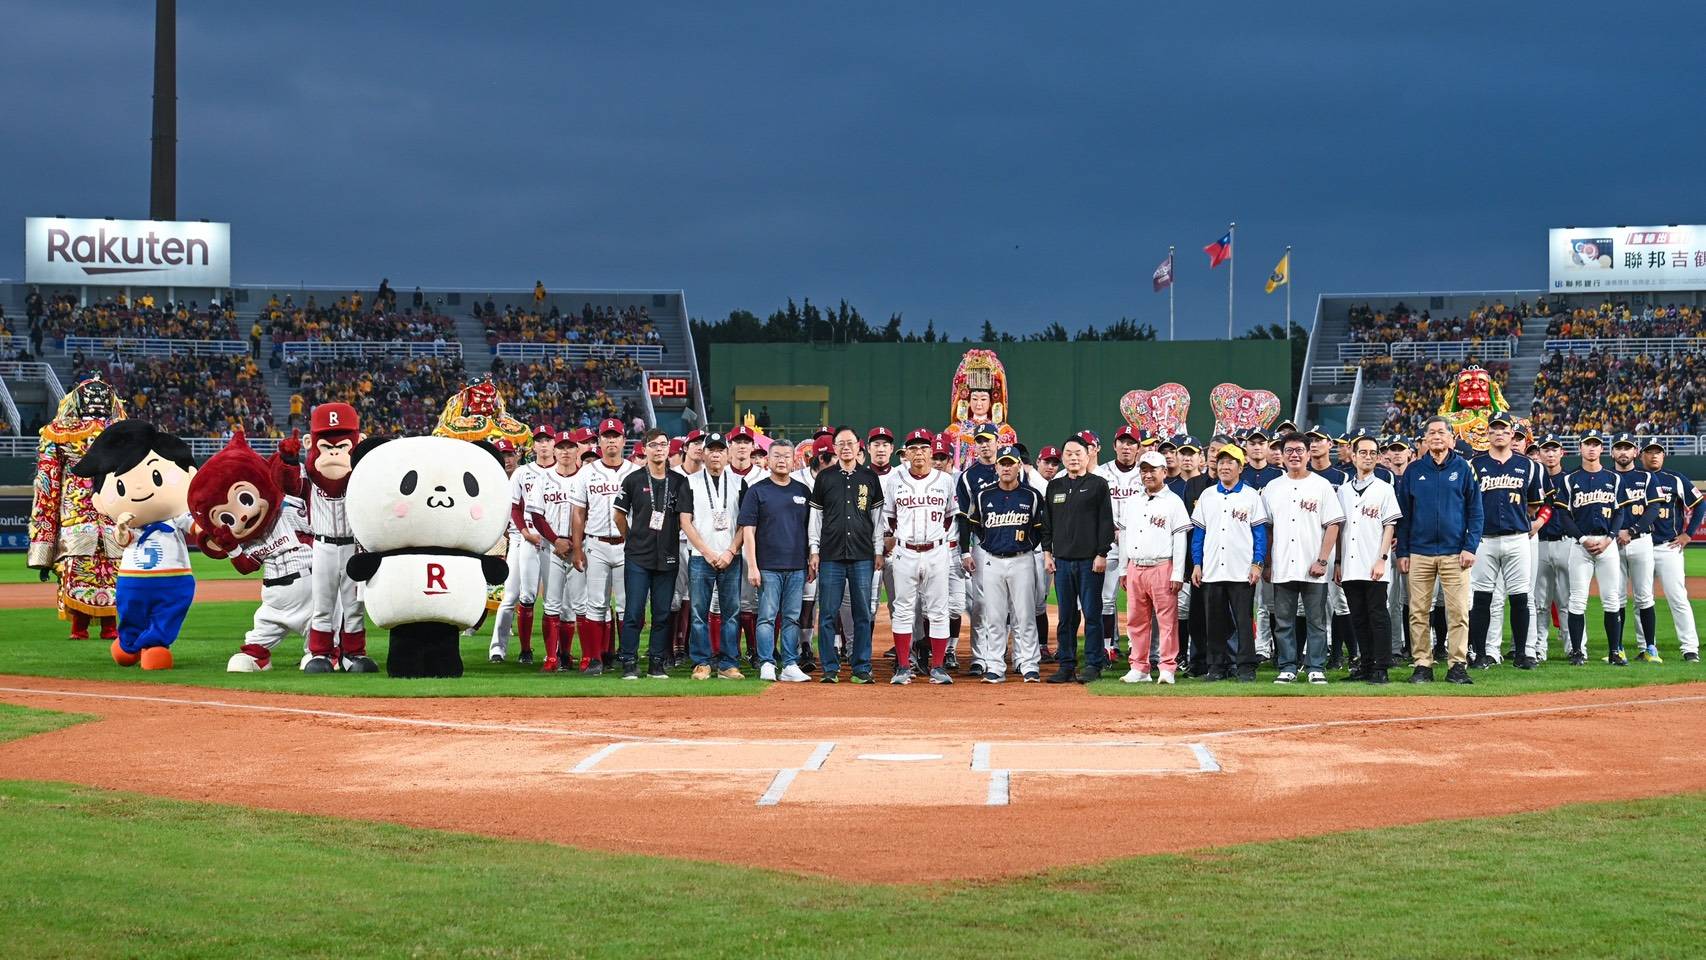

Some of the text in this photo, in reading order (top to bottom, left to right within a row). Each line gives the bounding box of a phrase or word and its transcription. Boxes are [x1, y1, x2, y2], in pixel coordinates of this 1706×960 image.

[48, 228, 208, 265] Rakuten
[329, 411, 340, 425] R
[608, 420, 615, 428] R
[1480, 474, 1524, 492] Brothers
[896, 495, 944, 507] Rakuten
[1573, 488, 1616, 508] Brothers
[931, 511, 943, 523] 87
[985, 510, 1030, 528] Brothers
[1015, 530, 1025, 541] 10
[253, 535, 289, 557] Rakuten
[427, 563, 448, 590] R
